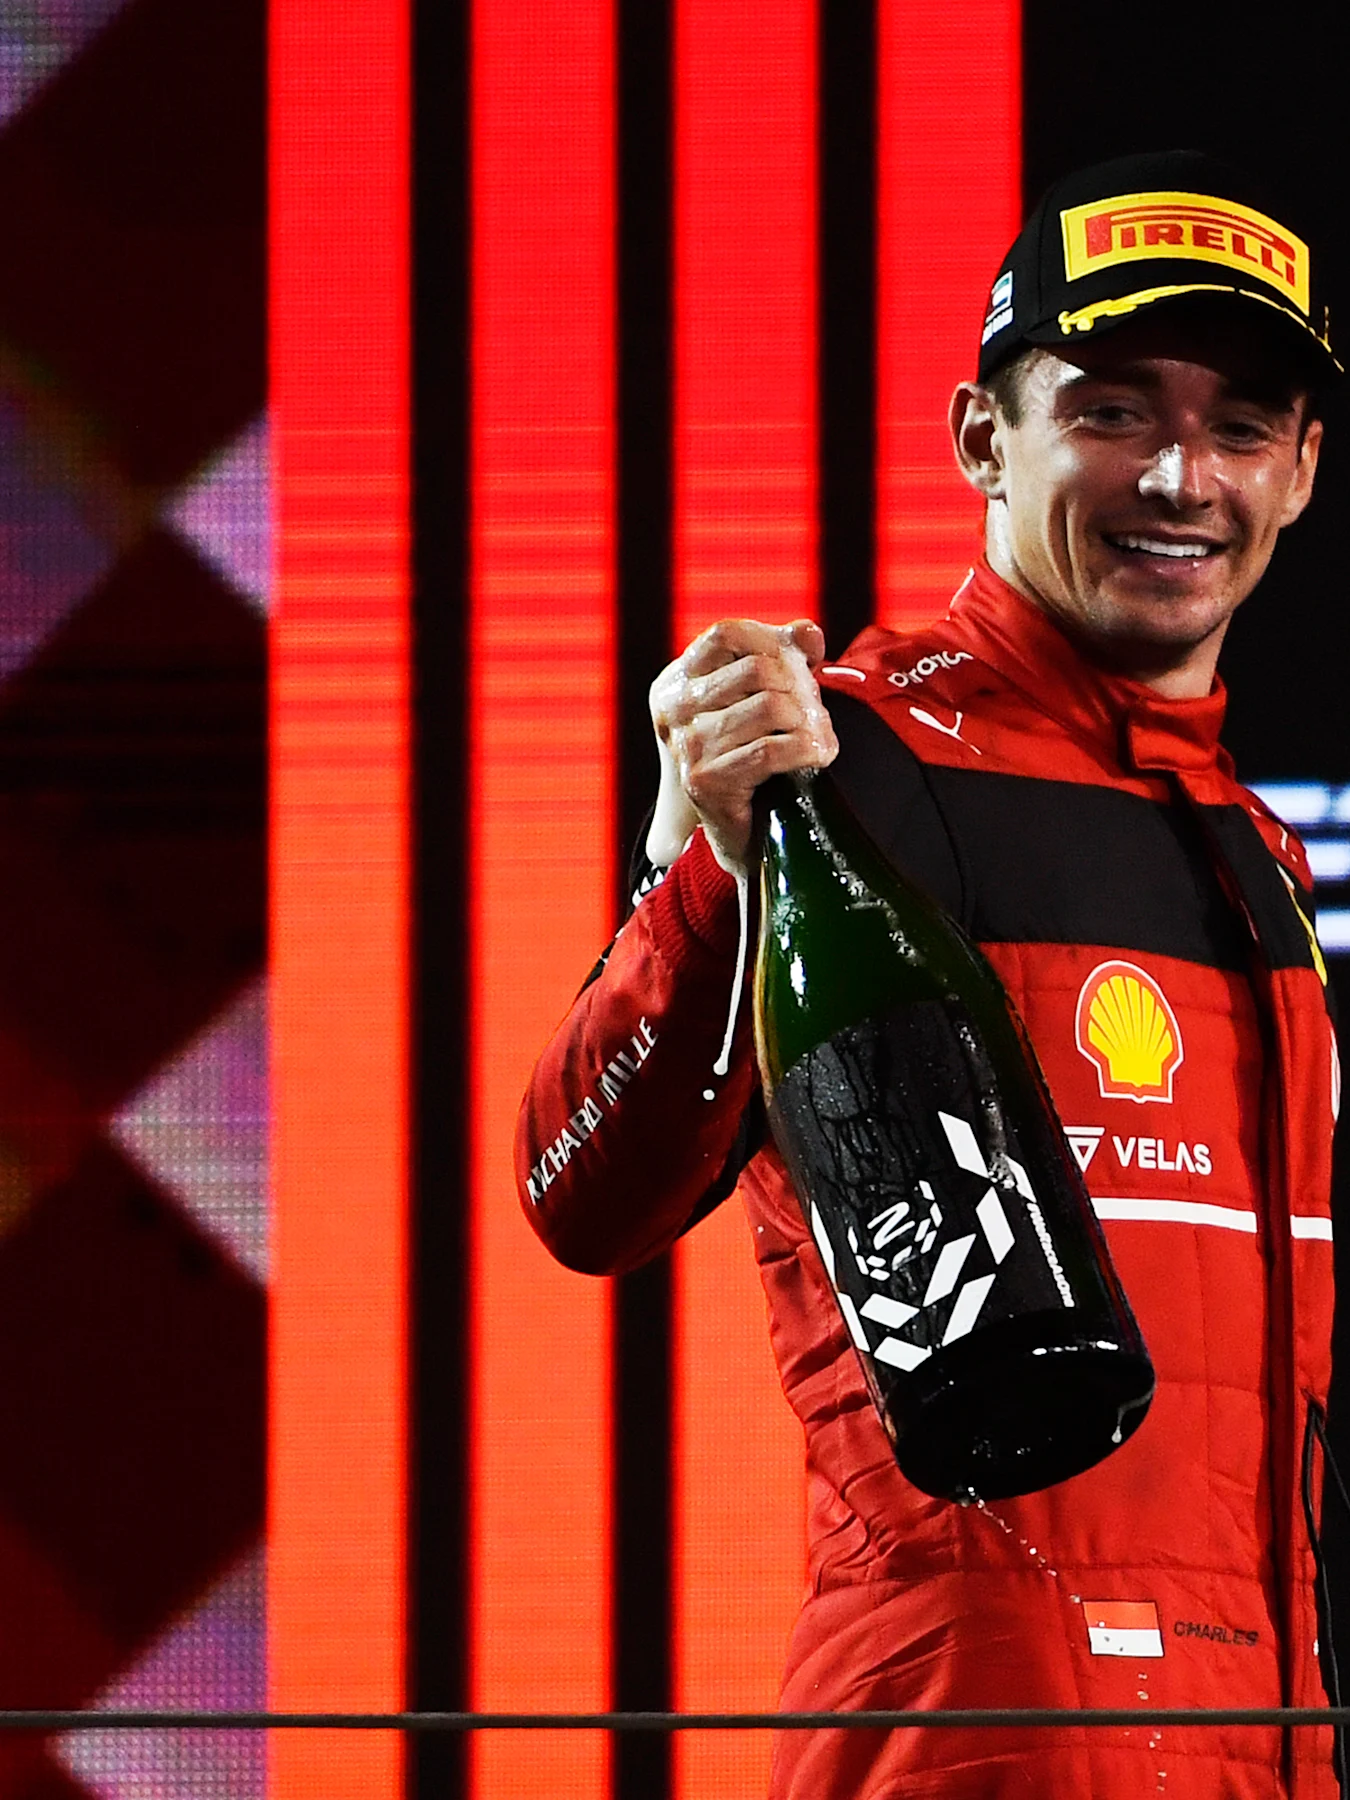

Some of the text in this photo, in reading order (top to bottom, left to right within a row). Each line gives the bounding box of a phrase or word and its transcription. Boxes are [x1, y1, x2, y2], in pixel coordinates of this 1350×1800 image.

[1084, 204, 1296, 287] PIRELLI
[1112, 1135, 1212, 1175] VELAS
[1173, 1620, 1260, 1647] CHARLES
